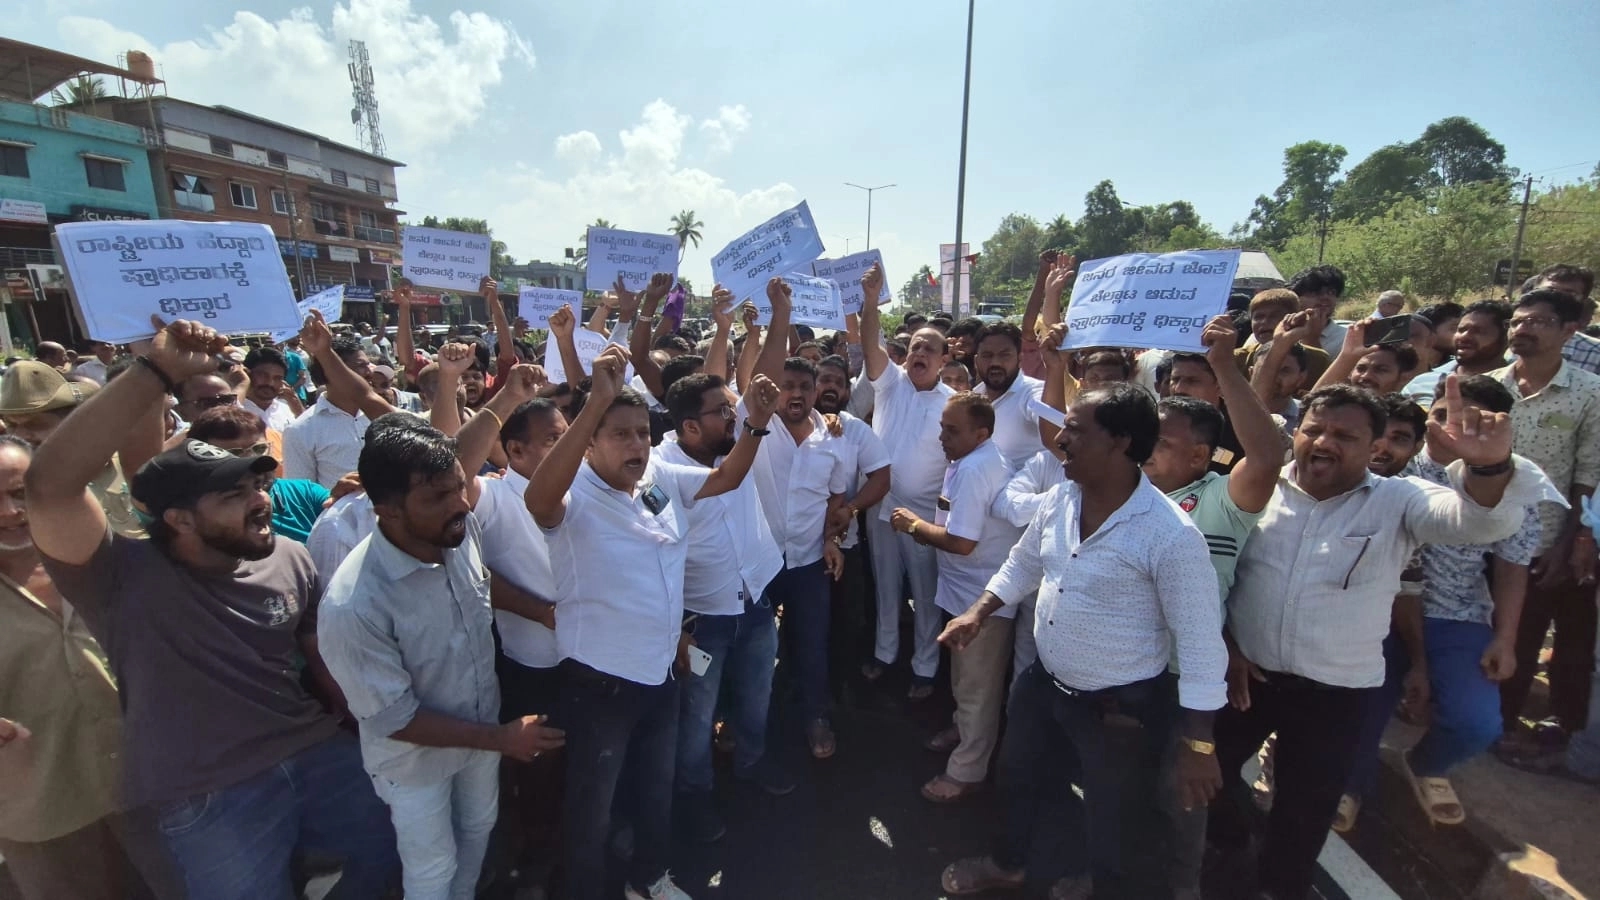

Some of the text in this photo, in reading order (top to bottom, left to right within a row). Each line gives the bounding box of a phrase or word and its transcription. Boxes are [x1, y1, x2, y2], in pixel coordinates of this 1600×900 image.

[77, 232, 185, 263] ರಾಷ್ಟ್ರೀಯ
[195, 231, 265, 258] ಹೆದ್ದಾರಿ
[119, 261, 250, 287] ಪ್ರಾಧಿಕಾರಕ್ಕೆ
[1081, 261, 1228, 282] ಜನರ ಜೀವದ ಜೊತೆ
[158, 292, 233, 319] ಧಿಕ್ಕಾರ
[1090, 287, 1198, 304] ಚೆಲ್ಲಾಟ ಆಡುವ
[1069, 311, 1208, 334] ಪ್ರಾಧಿಕಾರಕ್ಕೆ ಧಿಕ್ಕಾರ
